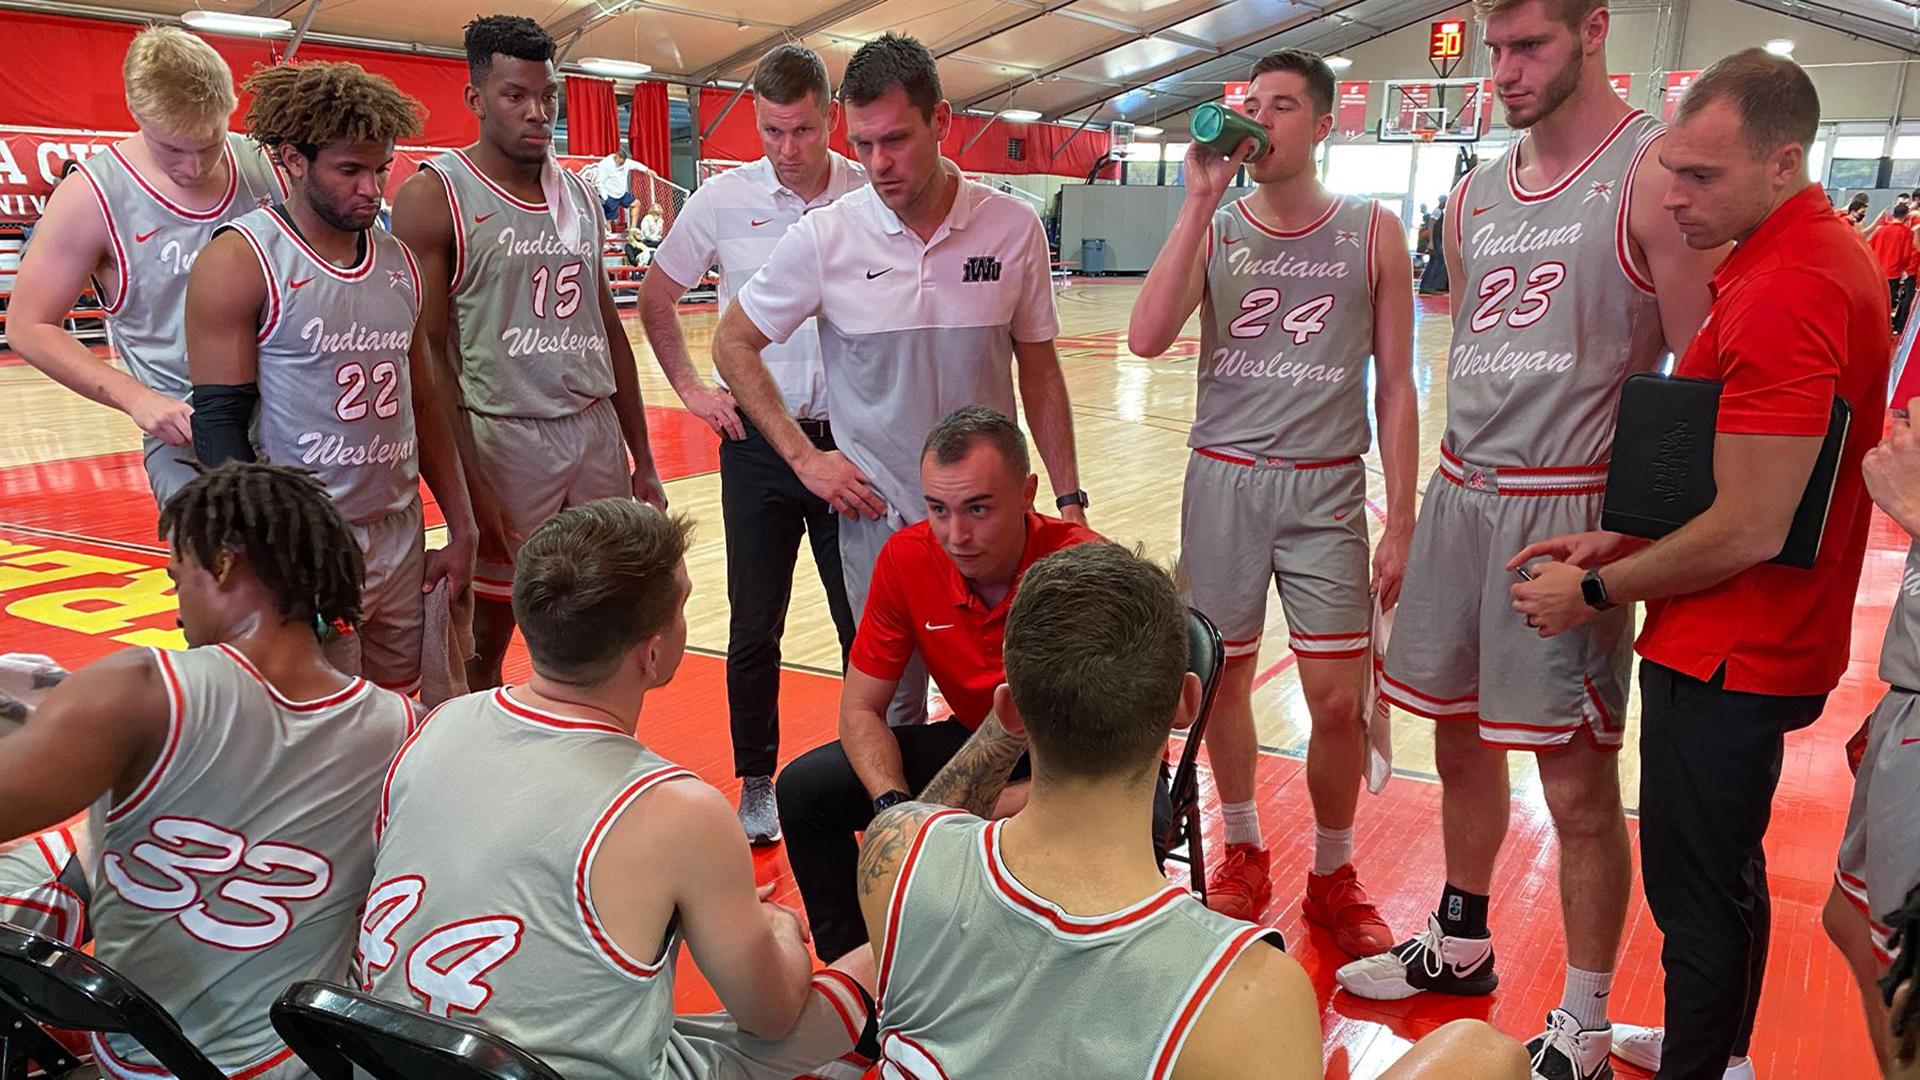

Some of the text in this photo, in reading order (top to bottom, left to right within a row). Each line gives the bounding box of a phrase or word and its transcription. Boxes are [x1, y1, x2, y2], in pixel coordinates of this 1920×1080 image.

[1433, 32, 1462, 55] 30
[498, 226, 594, 257] Indiaa
[1472, 221, 1583, 259] Indiana
[1228, 247, 1349, 278] Indiana
[533, 261, 583, 319] 15
[1470, 261, 1566, 333] 23
[301, 317, 410, 353] Indiana
[1228, 287, 1335, 345] 24
[1212, 347, 1345, 387] Wesleyan
[1452, 342, 1573, 380] Wesleyan
[335, 361, 398, 422] 22
[104, 815, 333, 951] 33
[357, 874, 524, 1018] 44
